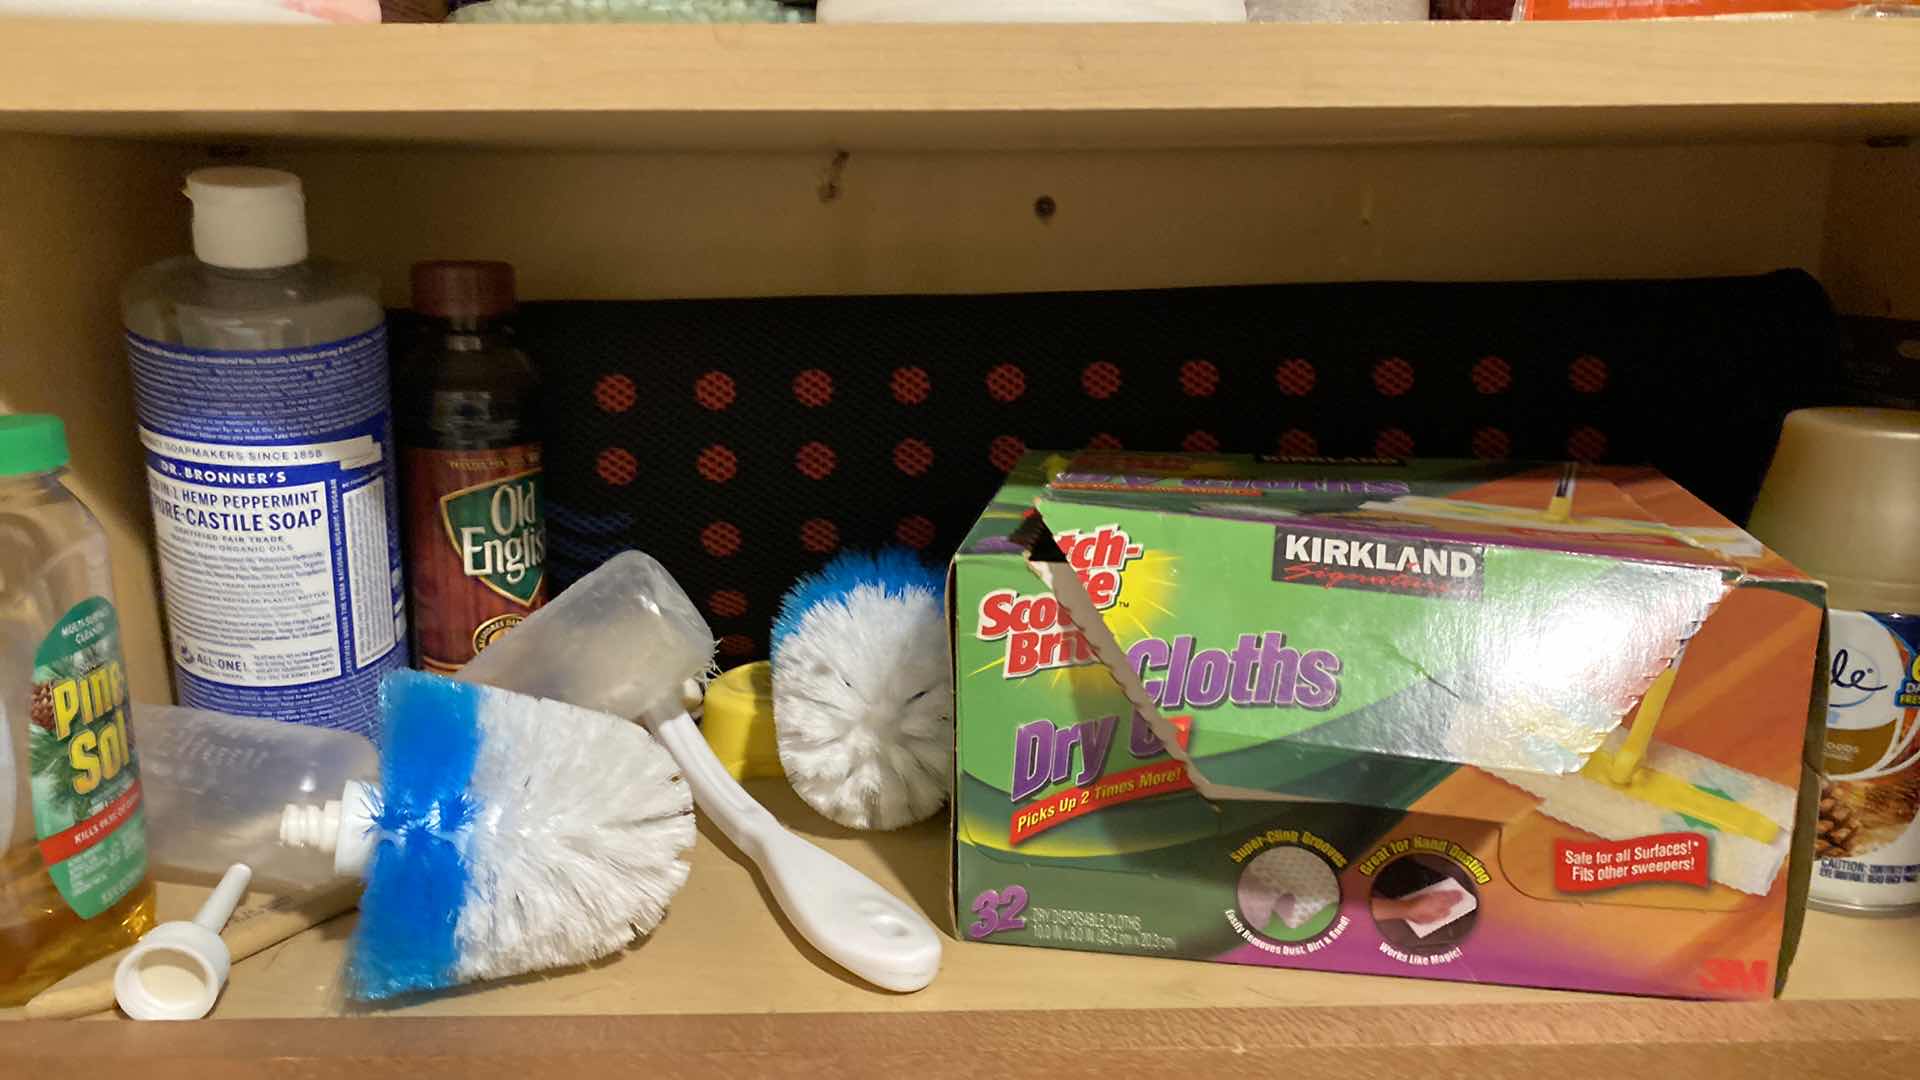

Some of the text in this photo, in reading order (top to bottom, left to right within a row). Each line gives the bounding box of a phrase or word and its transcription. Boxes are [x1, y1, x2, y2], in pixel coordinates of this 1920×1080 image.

[166, 444, 245, 461] SOAPMAKERS
[248, 450, 289, 461] SINCE
[184, 466, 287, 484] BRONNER'S
[182, 490, 218, 506] HEMP
[223, 489, 319, 508] PEPPERMINT
[269, 508, 323, 531] SOAP
[491, 481, 536, 536] Old
[461, 526, 546, 584] Englis
[1284, 534, 1477, 579] KIRKLAND
[1127, 631, 1341, 709] Cloths
[69, 708, 131, 795] Sol
[1010, 716, 1119, 802] Dry
[1017, 769, 1182, 833] Picks Up 2 Times More!
[73, 824, 99, 845] KILLS
[1564, 849, 1593, 866] Safe
[1595, 849, 1614, 865] for
[1616, 848, 1631, 863] all
[1359, 845, 1391, 877] Great
[1413, 835, 1447, 852] Hand
[1448, 842, 1491, 886] Dusting
[1572, 857, 1696, 883] Fits other sweepers!
[969, 885, 1029, 938] 32
[1224, 908, 1245, 934] Easily
[1241, 929, 1281, 955] Removes
[1379, 941, 1464, 966] Works Like Magic!
[1701, 959, 1769, 993] 3M
